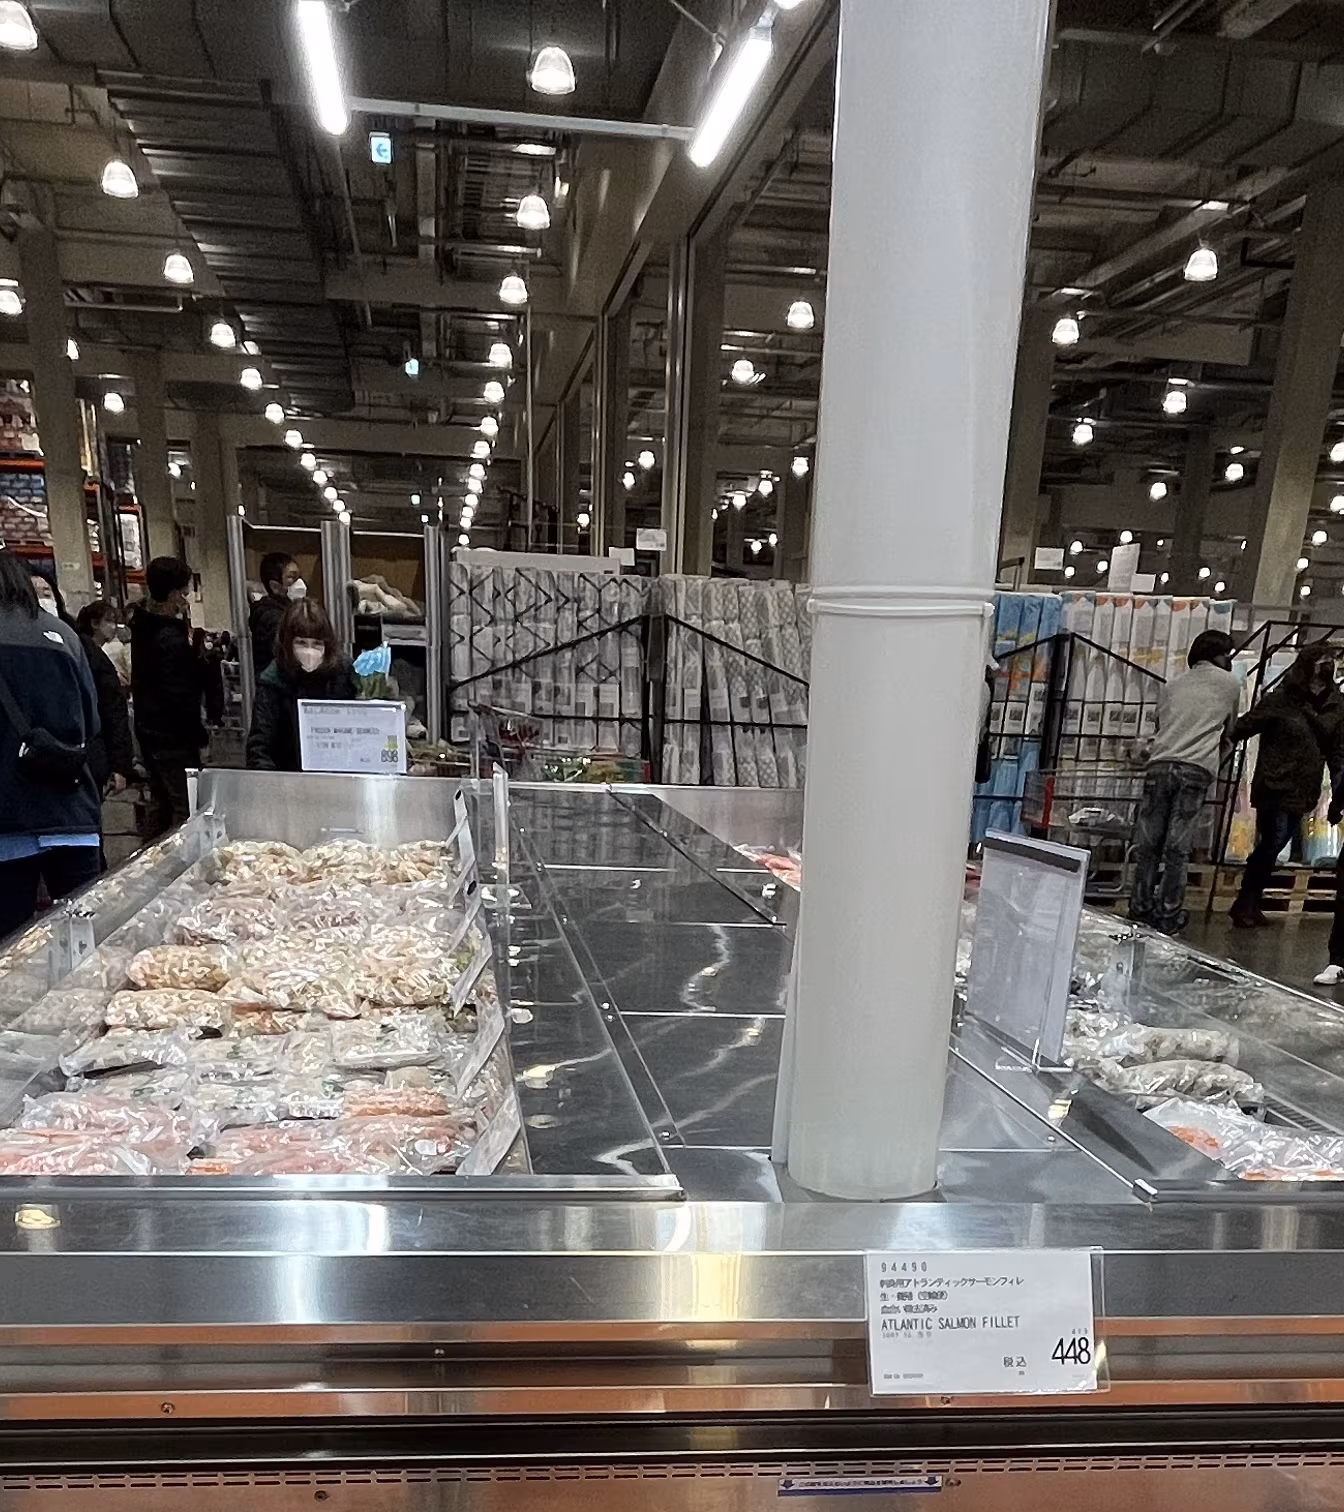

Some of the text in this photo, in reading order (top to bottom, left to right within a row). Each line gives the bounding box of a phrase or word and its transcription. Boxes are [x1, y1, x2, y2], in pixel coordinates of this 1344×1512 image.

[881, 1261, 928, 1273] 94490
[881, 1316, 1020, 1331] ATLANTIC SALMON FILLET
[1051, 1337, 1091, 1365] 448
